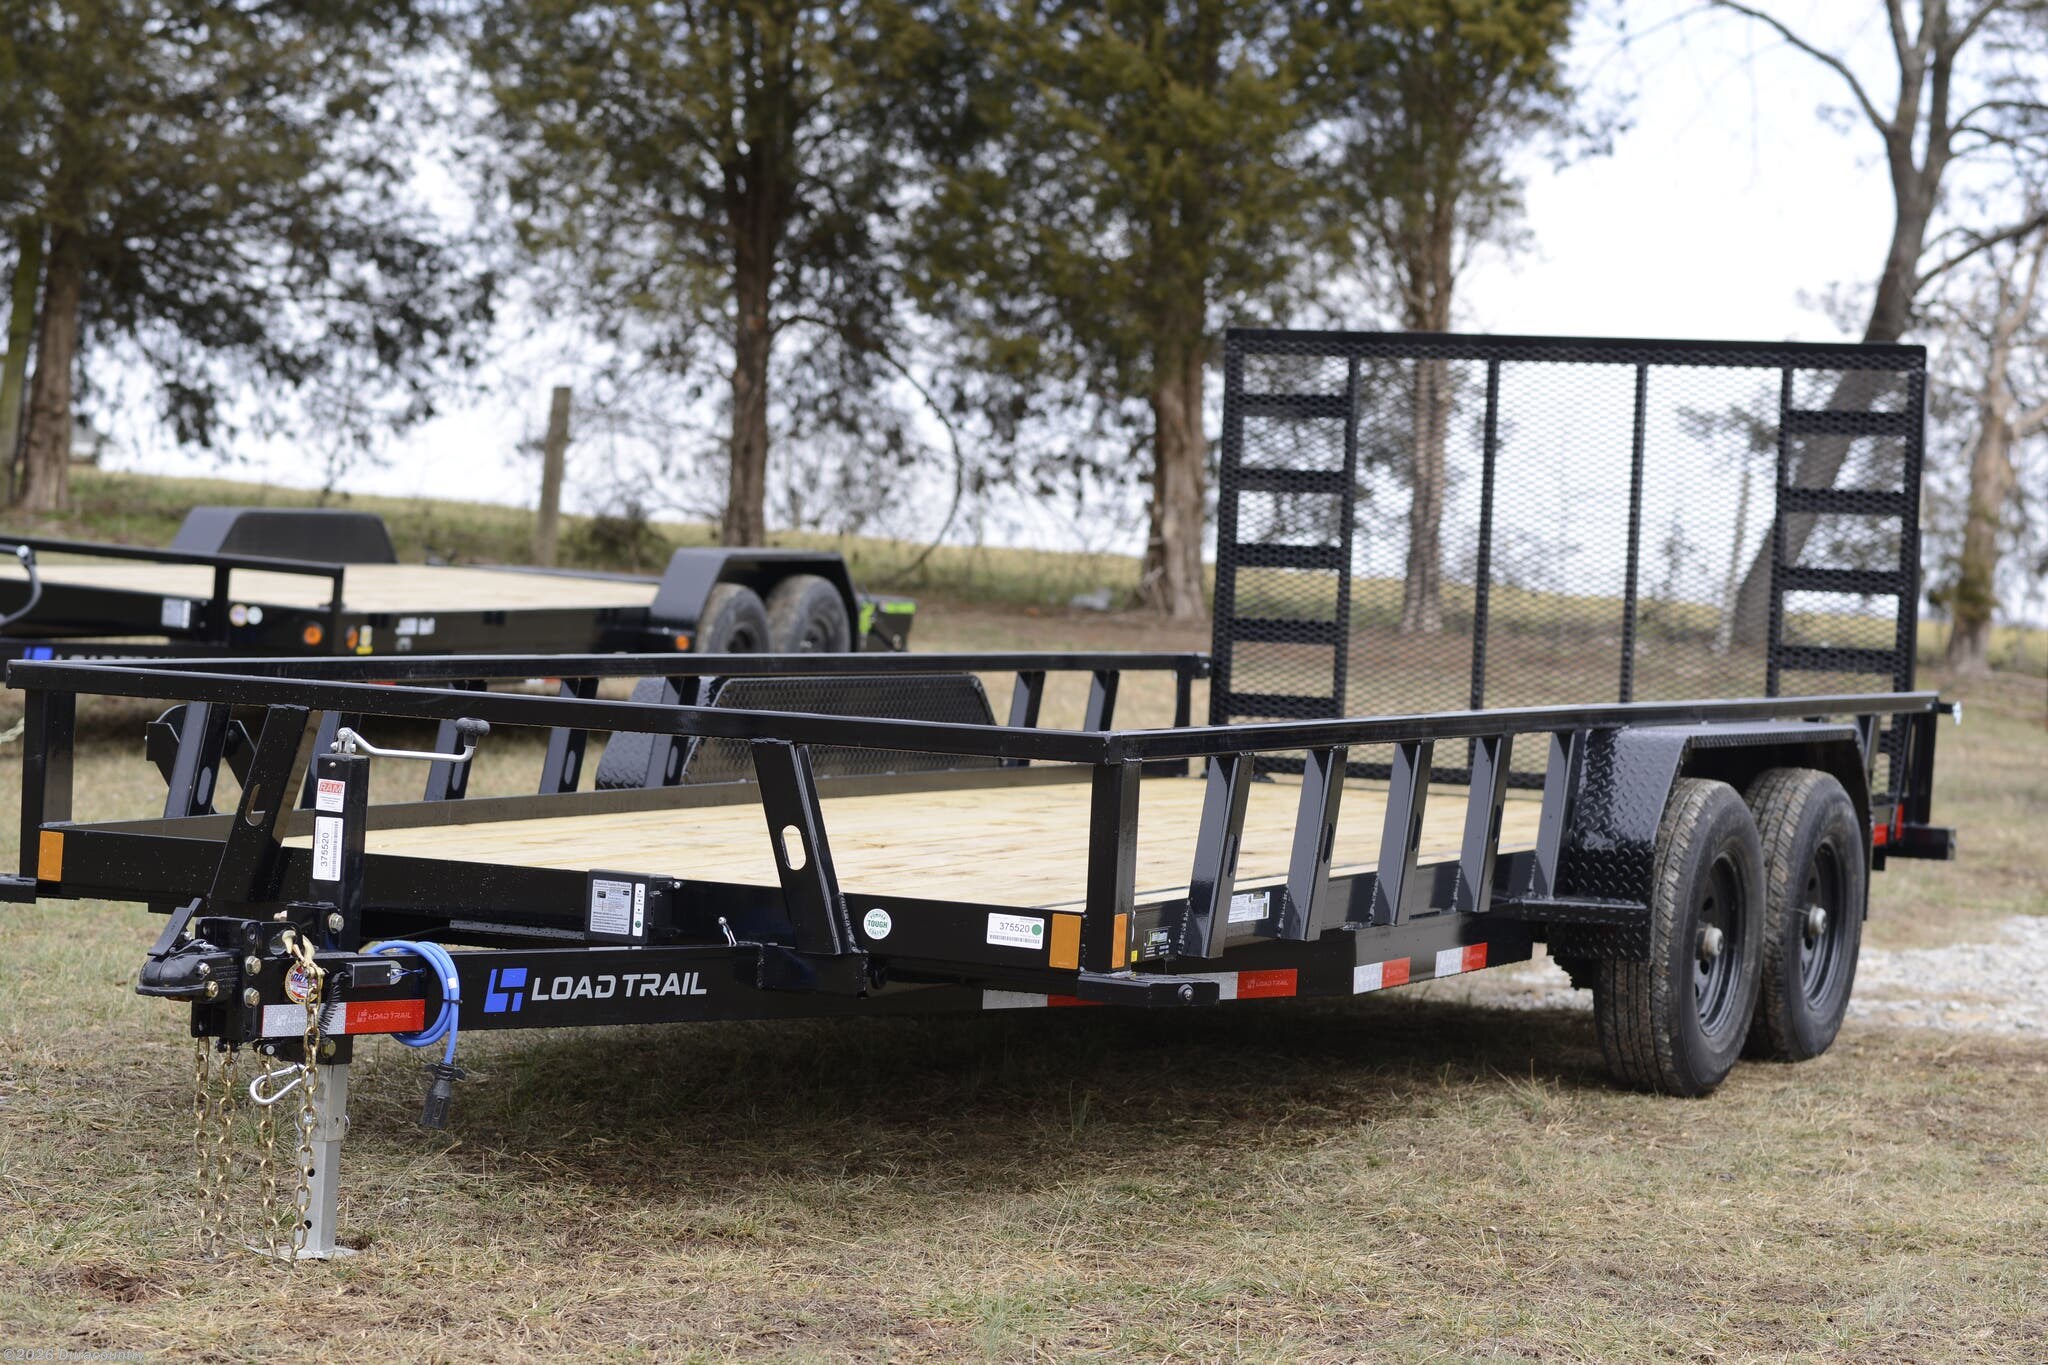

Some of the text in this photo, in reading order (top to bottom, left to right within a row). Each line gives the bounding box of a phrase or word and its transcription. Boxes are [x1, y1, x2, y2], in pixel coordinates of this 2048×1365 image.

[319, 782, 344, 794] RAM
[320, 832, 330, 867] 375520
[867, 919, 888, 929] TOUGH
[999, 922, 1031, 934] 375520
[531, 972, 708, 1001] LOAD TRAIL
